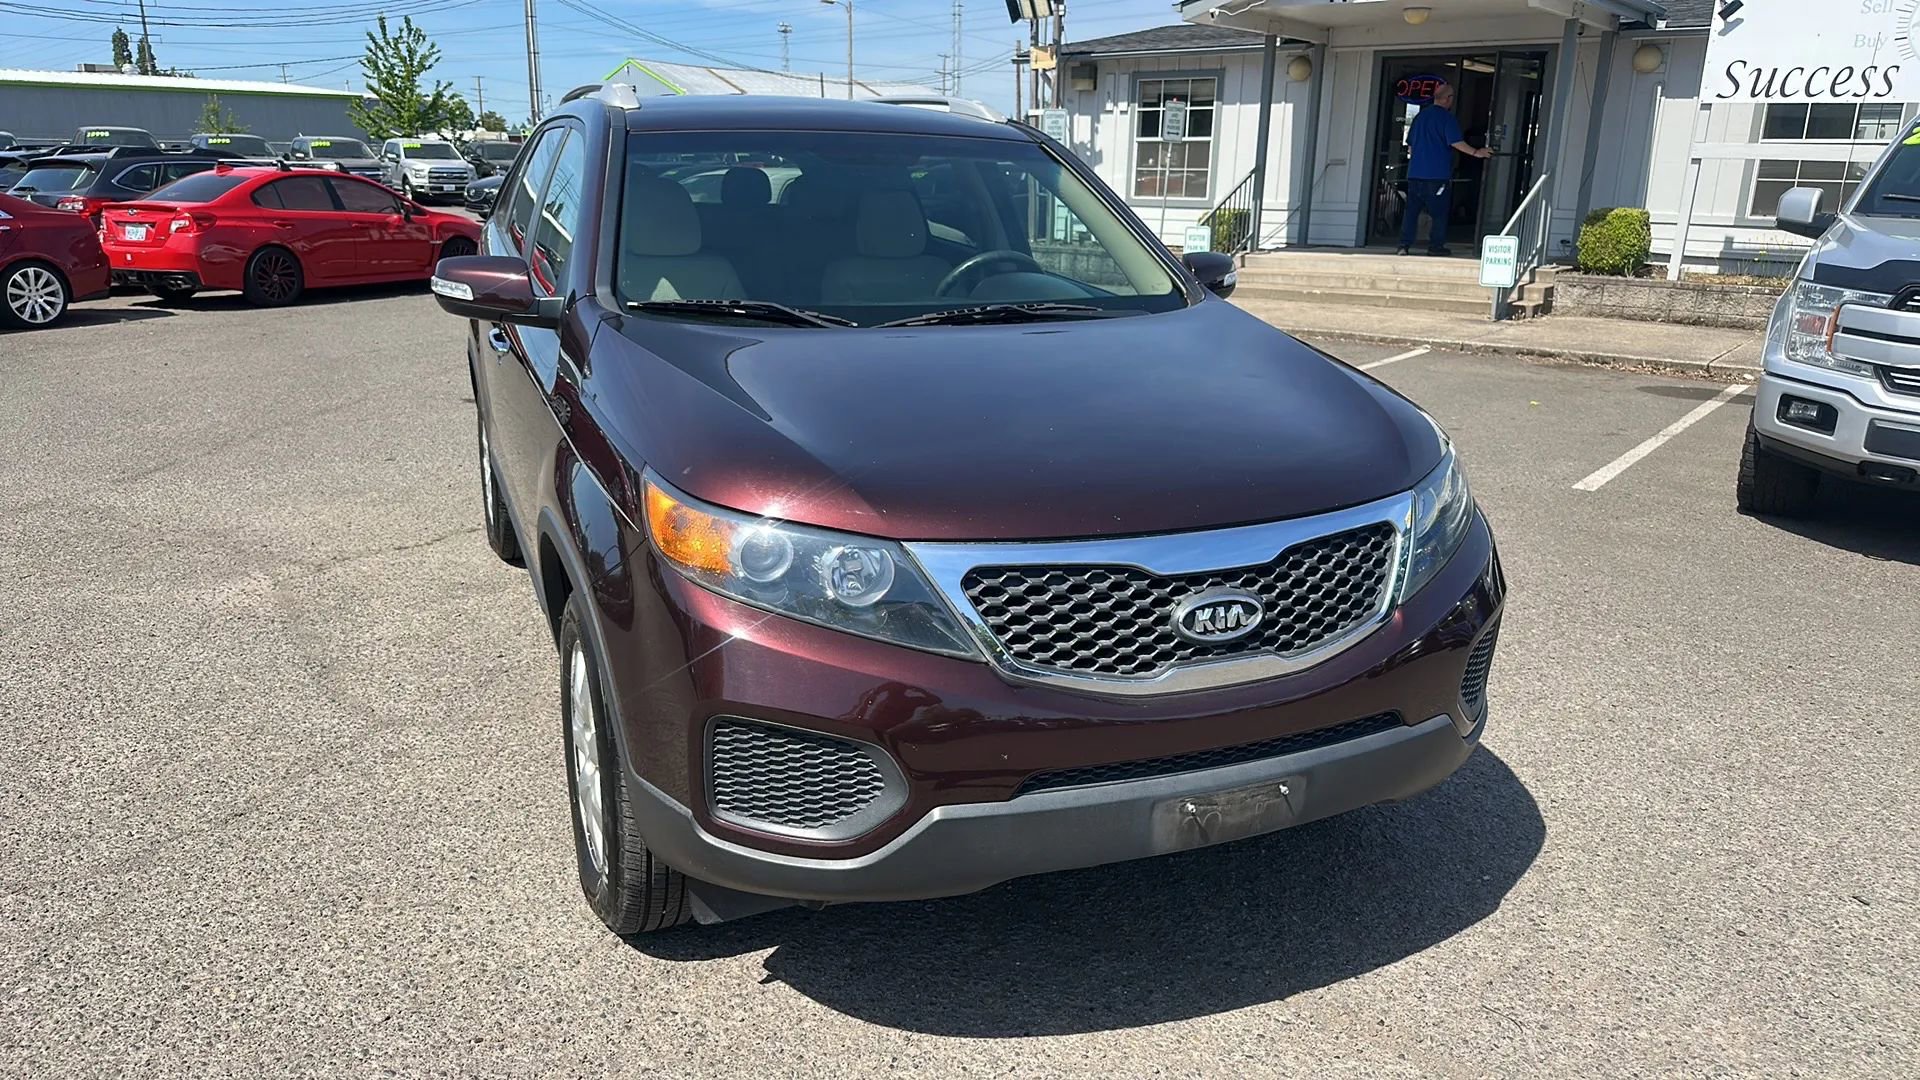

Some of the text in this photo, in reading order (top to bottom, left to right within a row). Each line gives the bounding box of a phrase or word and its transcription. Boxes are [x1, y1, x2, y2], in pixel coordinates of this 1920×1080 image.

[1854, 34, 1888, 50] Buy
[1715, 59, 1900, 99] Success
[1488, 245, 1512, 254] VISITOR
[1485, 257, 1512, 266] PARKING
[1193, 604, 1248, 633] KIA
